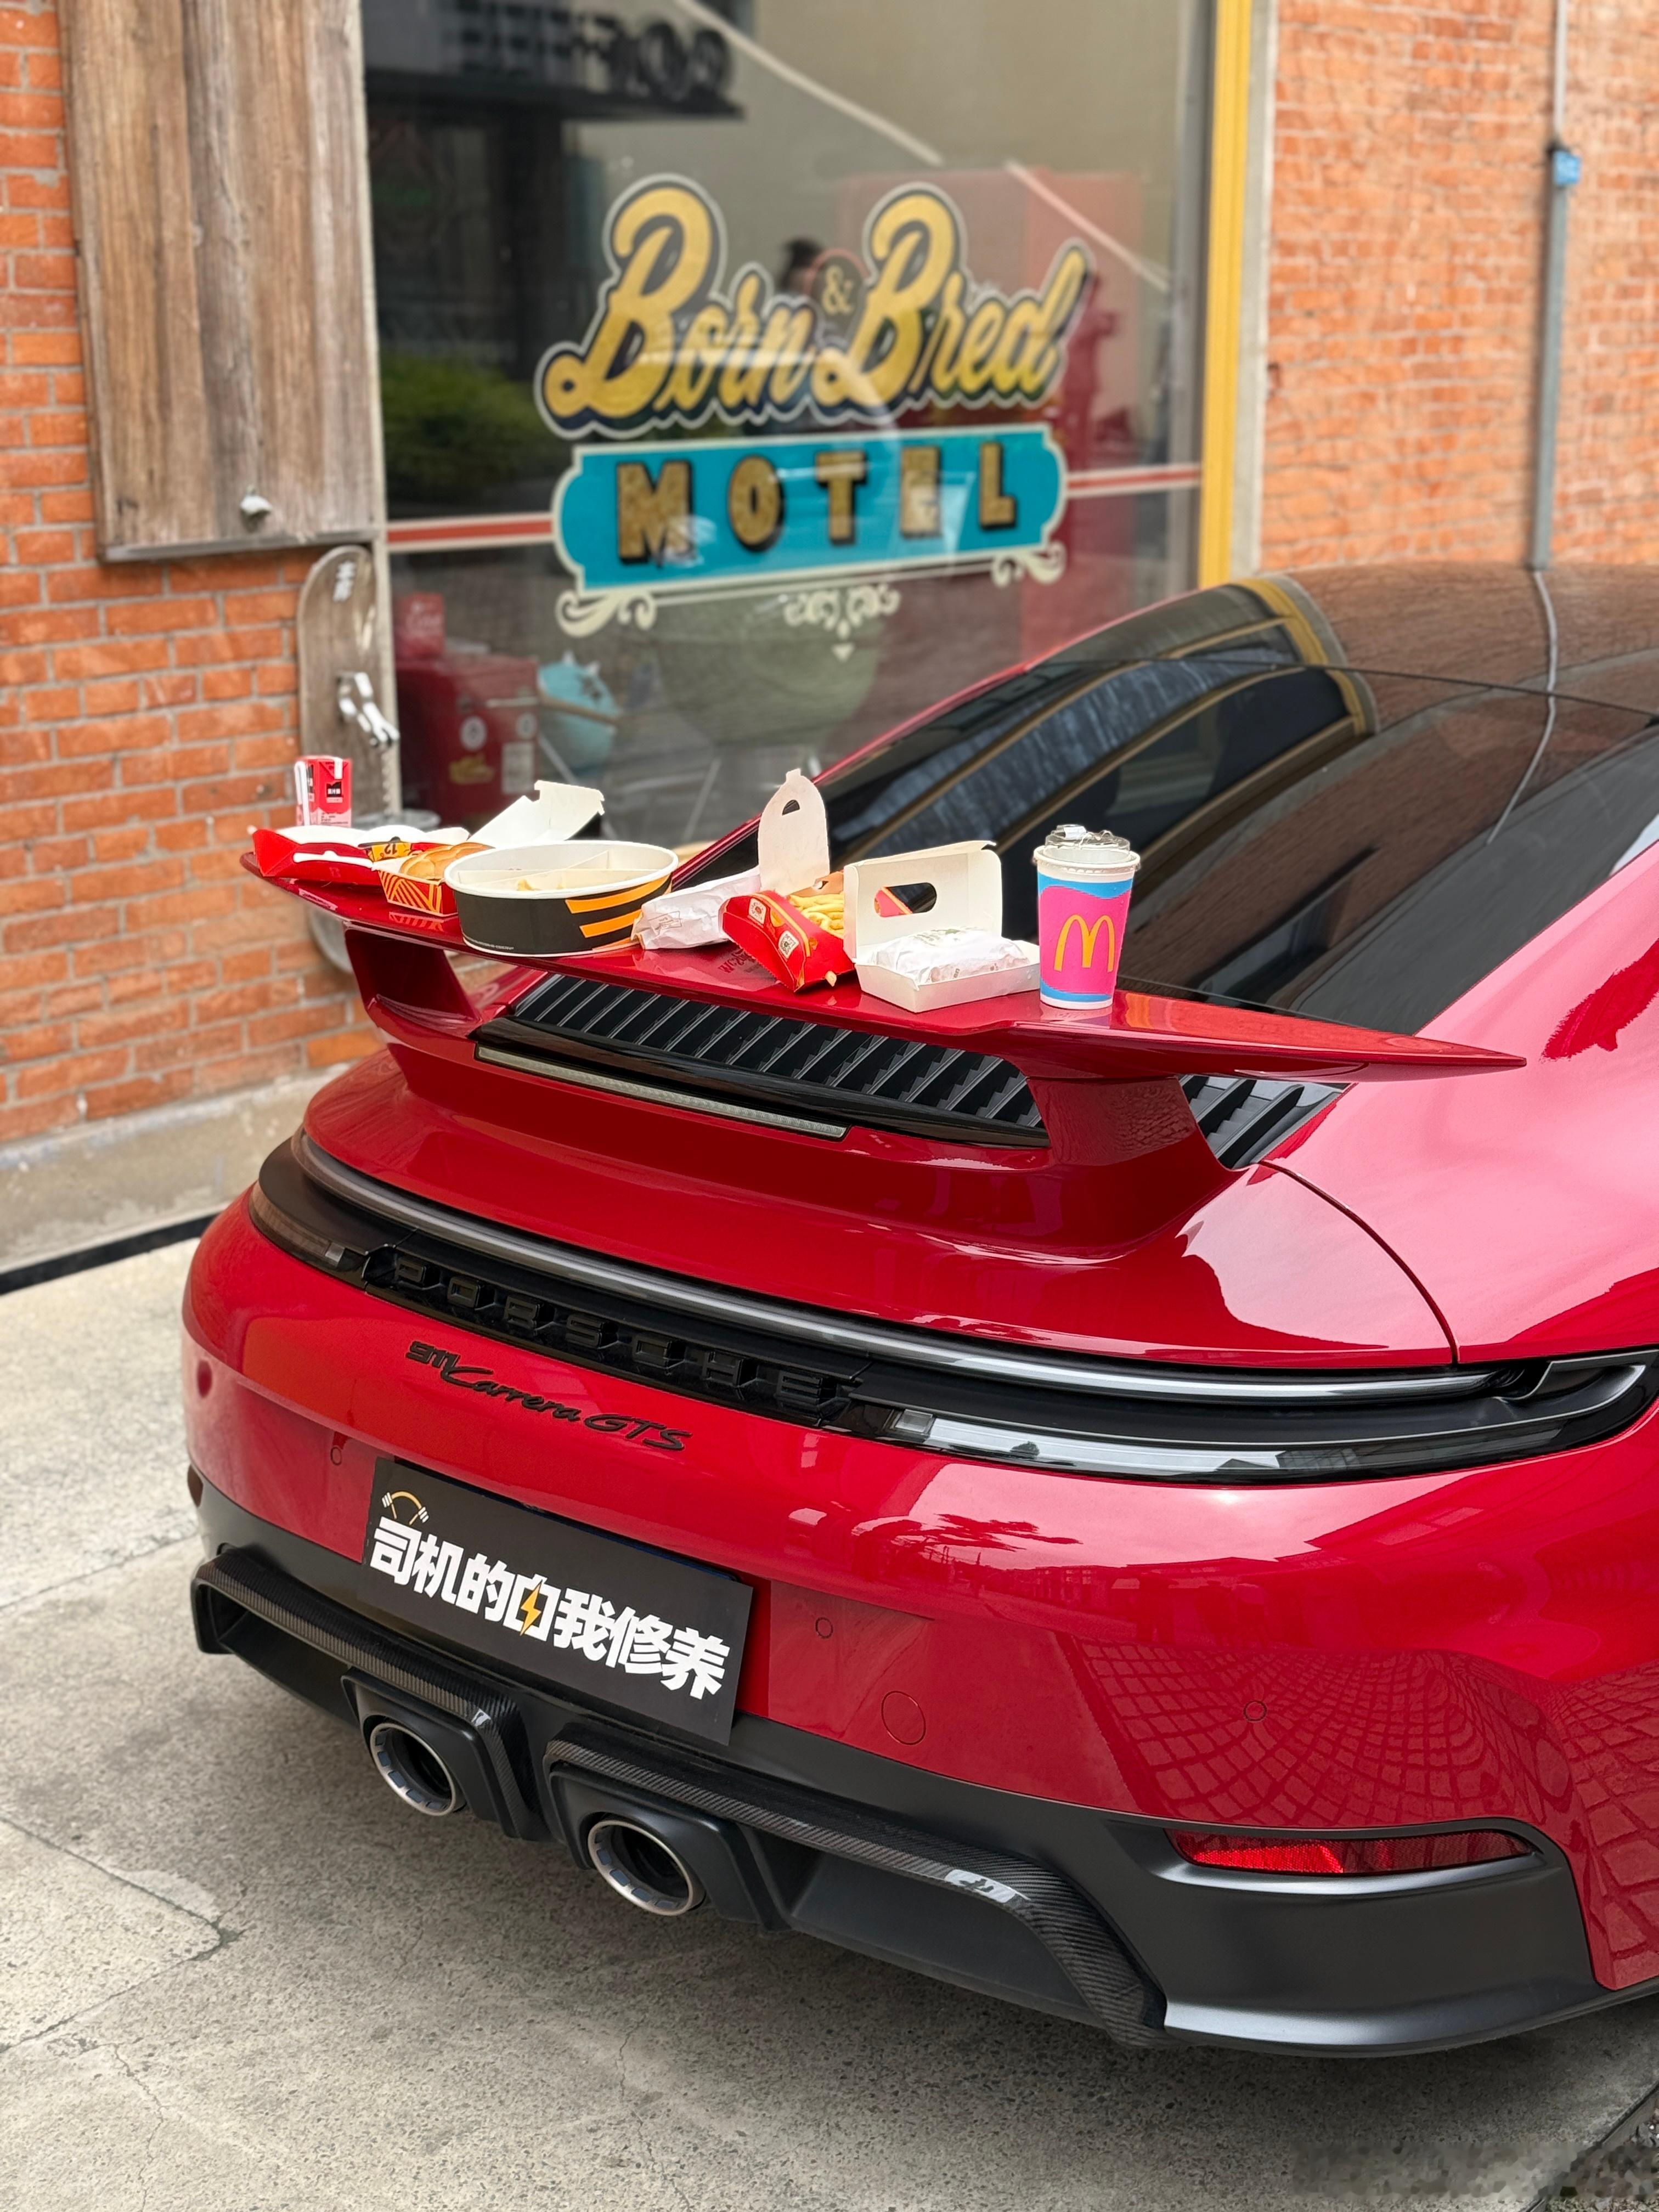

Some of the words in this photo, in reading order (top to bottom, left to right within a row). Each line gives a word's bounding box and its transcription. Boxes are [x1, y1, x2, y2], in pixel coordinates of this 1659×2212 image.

[546, 187, 816, 418] Born
[809, 193, 1087, 408] Bred
[821, 264, 854, 316] &
[616, 441, 1017, 566] MOTEL
[394, 1256, 830, 1406] PORSCHE
[405, 1340, 461, 1373] 911
[441, 1366, 582, 1423] Carrera
[584, 1413, 693, 1452] GTS
[369, 1516, 731, 1701] 司机的自我修养
